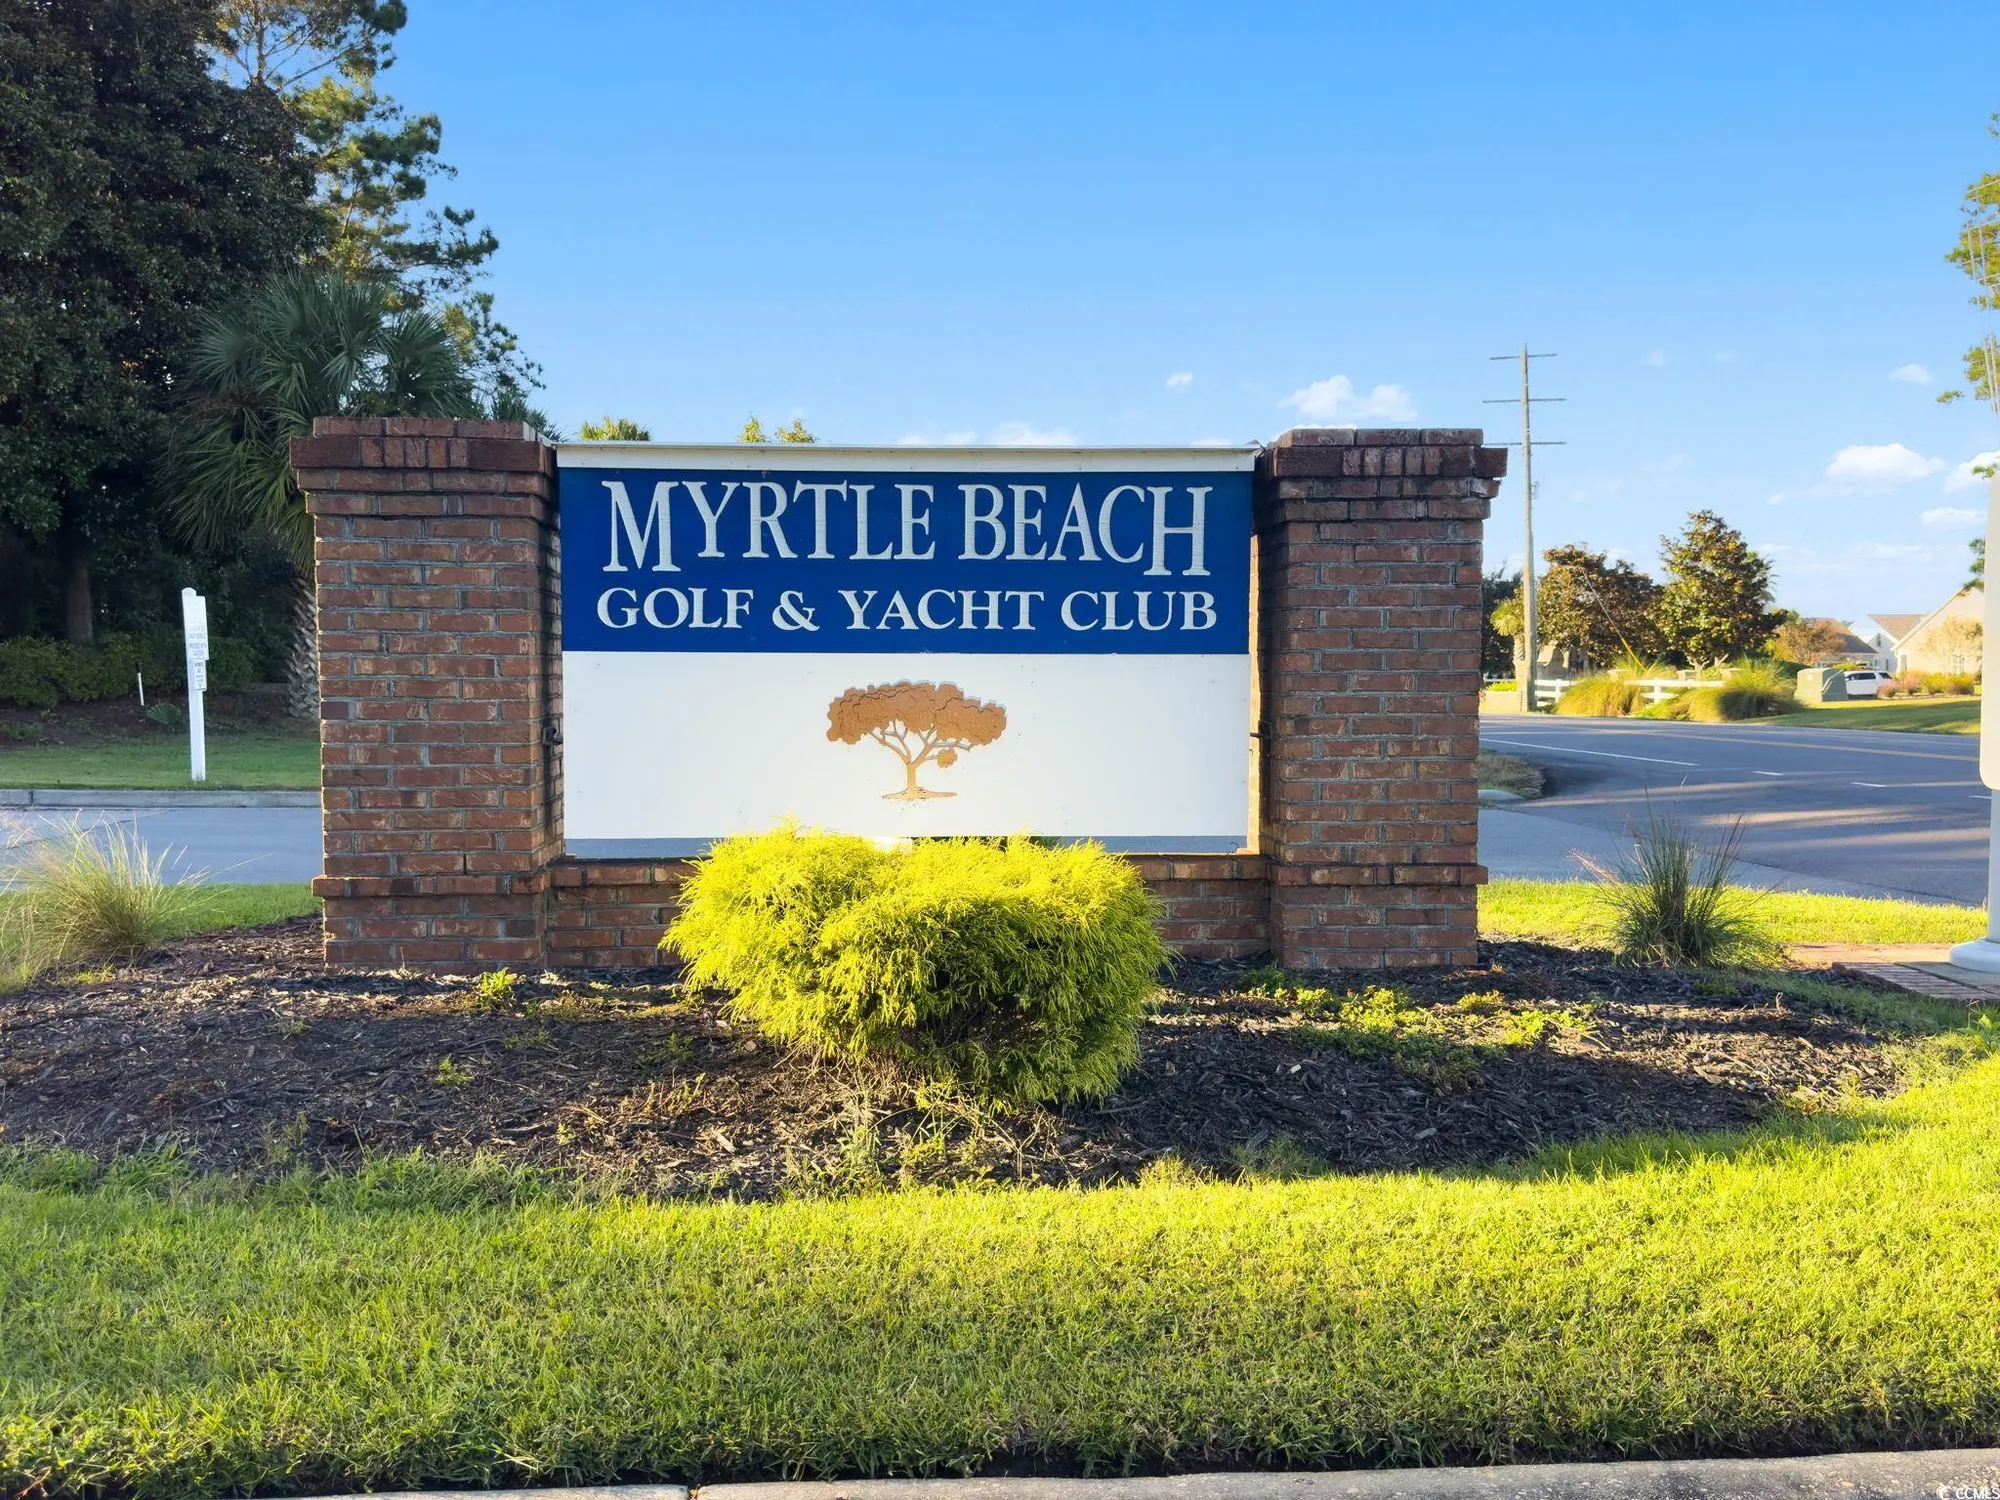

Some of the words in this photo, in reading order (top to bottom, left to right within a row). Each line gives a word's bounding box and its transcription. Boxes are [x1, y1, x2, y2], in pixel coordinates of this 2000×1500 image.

[602, 480, 935, 572] MYRTLE
[958, 482, 1213, 577] BEACH
[597, 587, 754, 629] GOLF
[772, 590, 820, 632] &
[838, 589, 1045, 631] YACHT
[1060, 590, 1217, 631] CLUB
